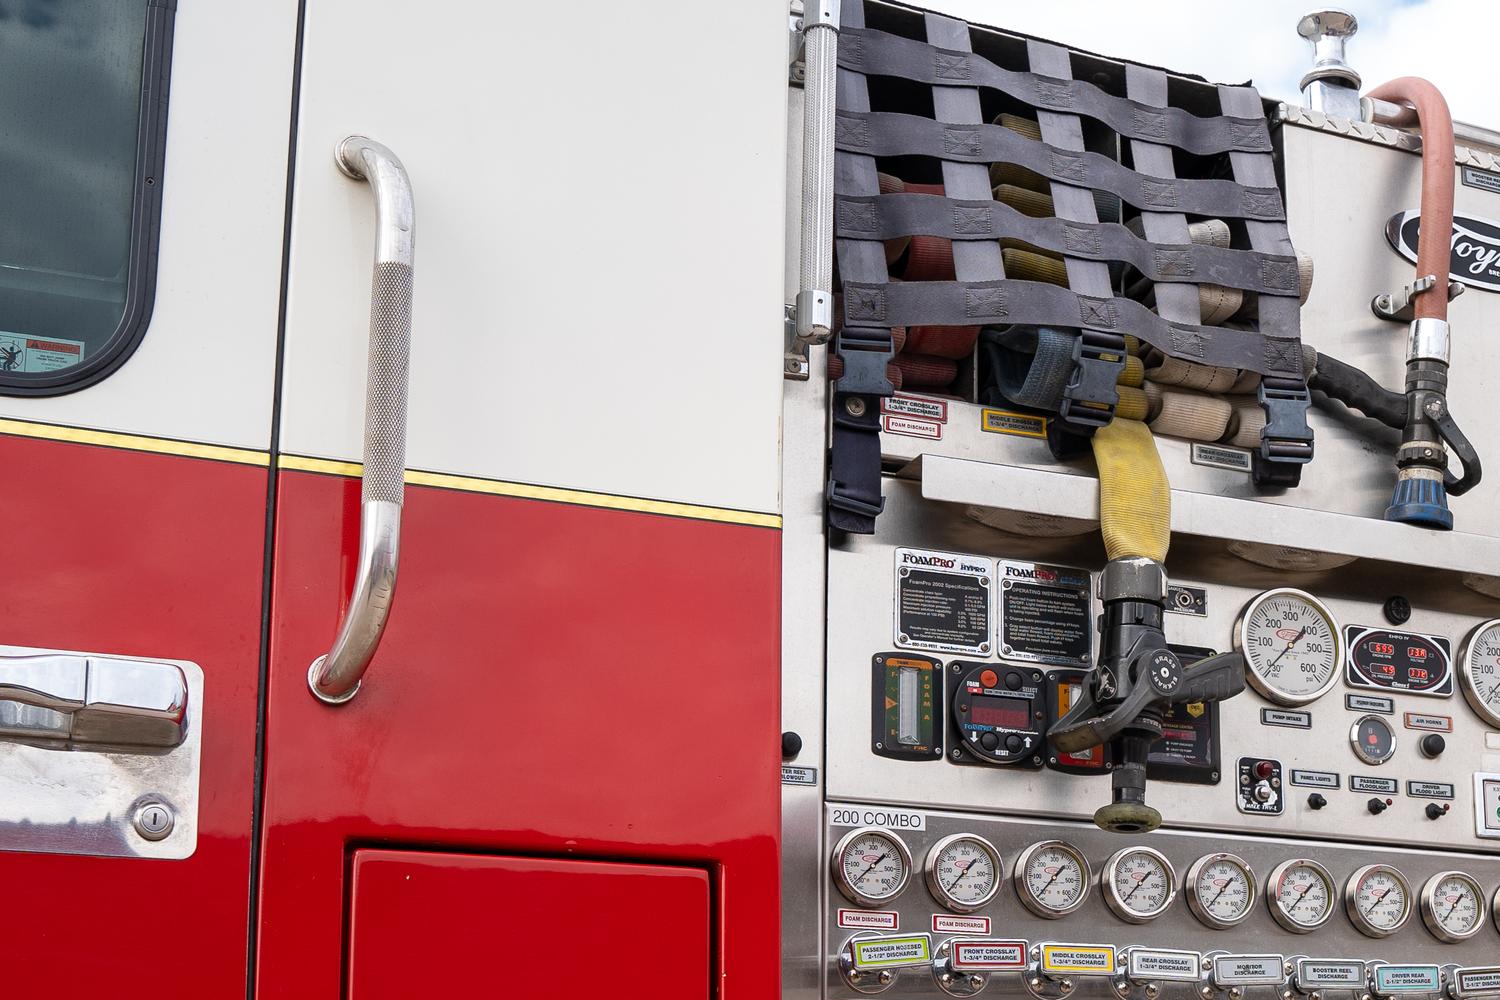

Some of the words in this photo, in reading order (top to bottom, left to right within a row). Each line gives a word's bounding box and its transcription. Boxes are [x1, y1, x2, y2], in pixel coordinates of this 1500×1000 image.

[910, 401, 939, 410] CROSSLAY
[907, 407, 940, 416] DISCHARGE
[907, 424, 935, 432] DISCHARGE
[902, 553, 954, 568] FOAMPRO
[960, 564, 986, 573] HYPRO
[1283, 611, 1298, 621] 300
[1266, 619, 1281, 628] 200
[1258, 637, 1273, 646] 100
[1307, 643, 1322, 653] 500
[1486, 647, 1500, 656] 200
[1154, 655, 1176, 670] BRASS
[1300, 663, 1316, 673] 600
[1481, 665, 1493, 674] 100
[1152, 670, 1178, 690] ELKHART
[833, 810, 859, 824] 200
[864, 812, 921, 827] COMBO
